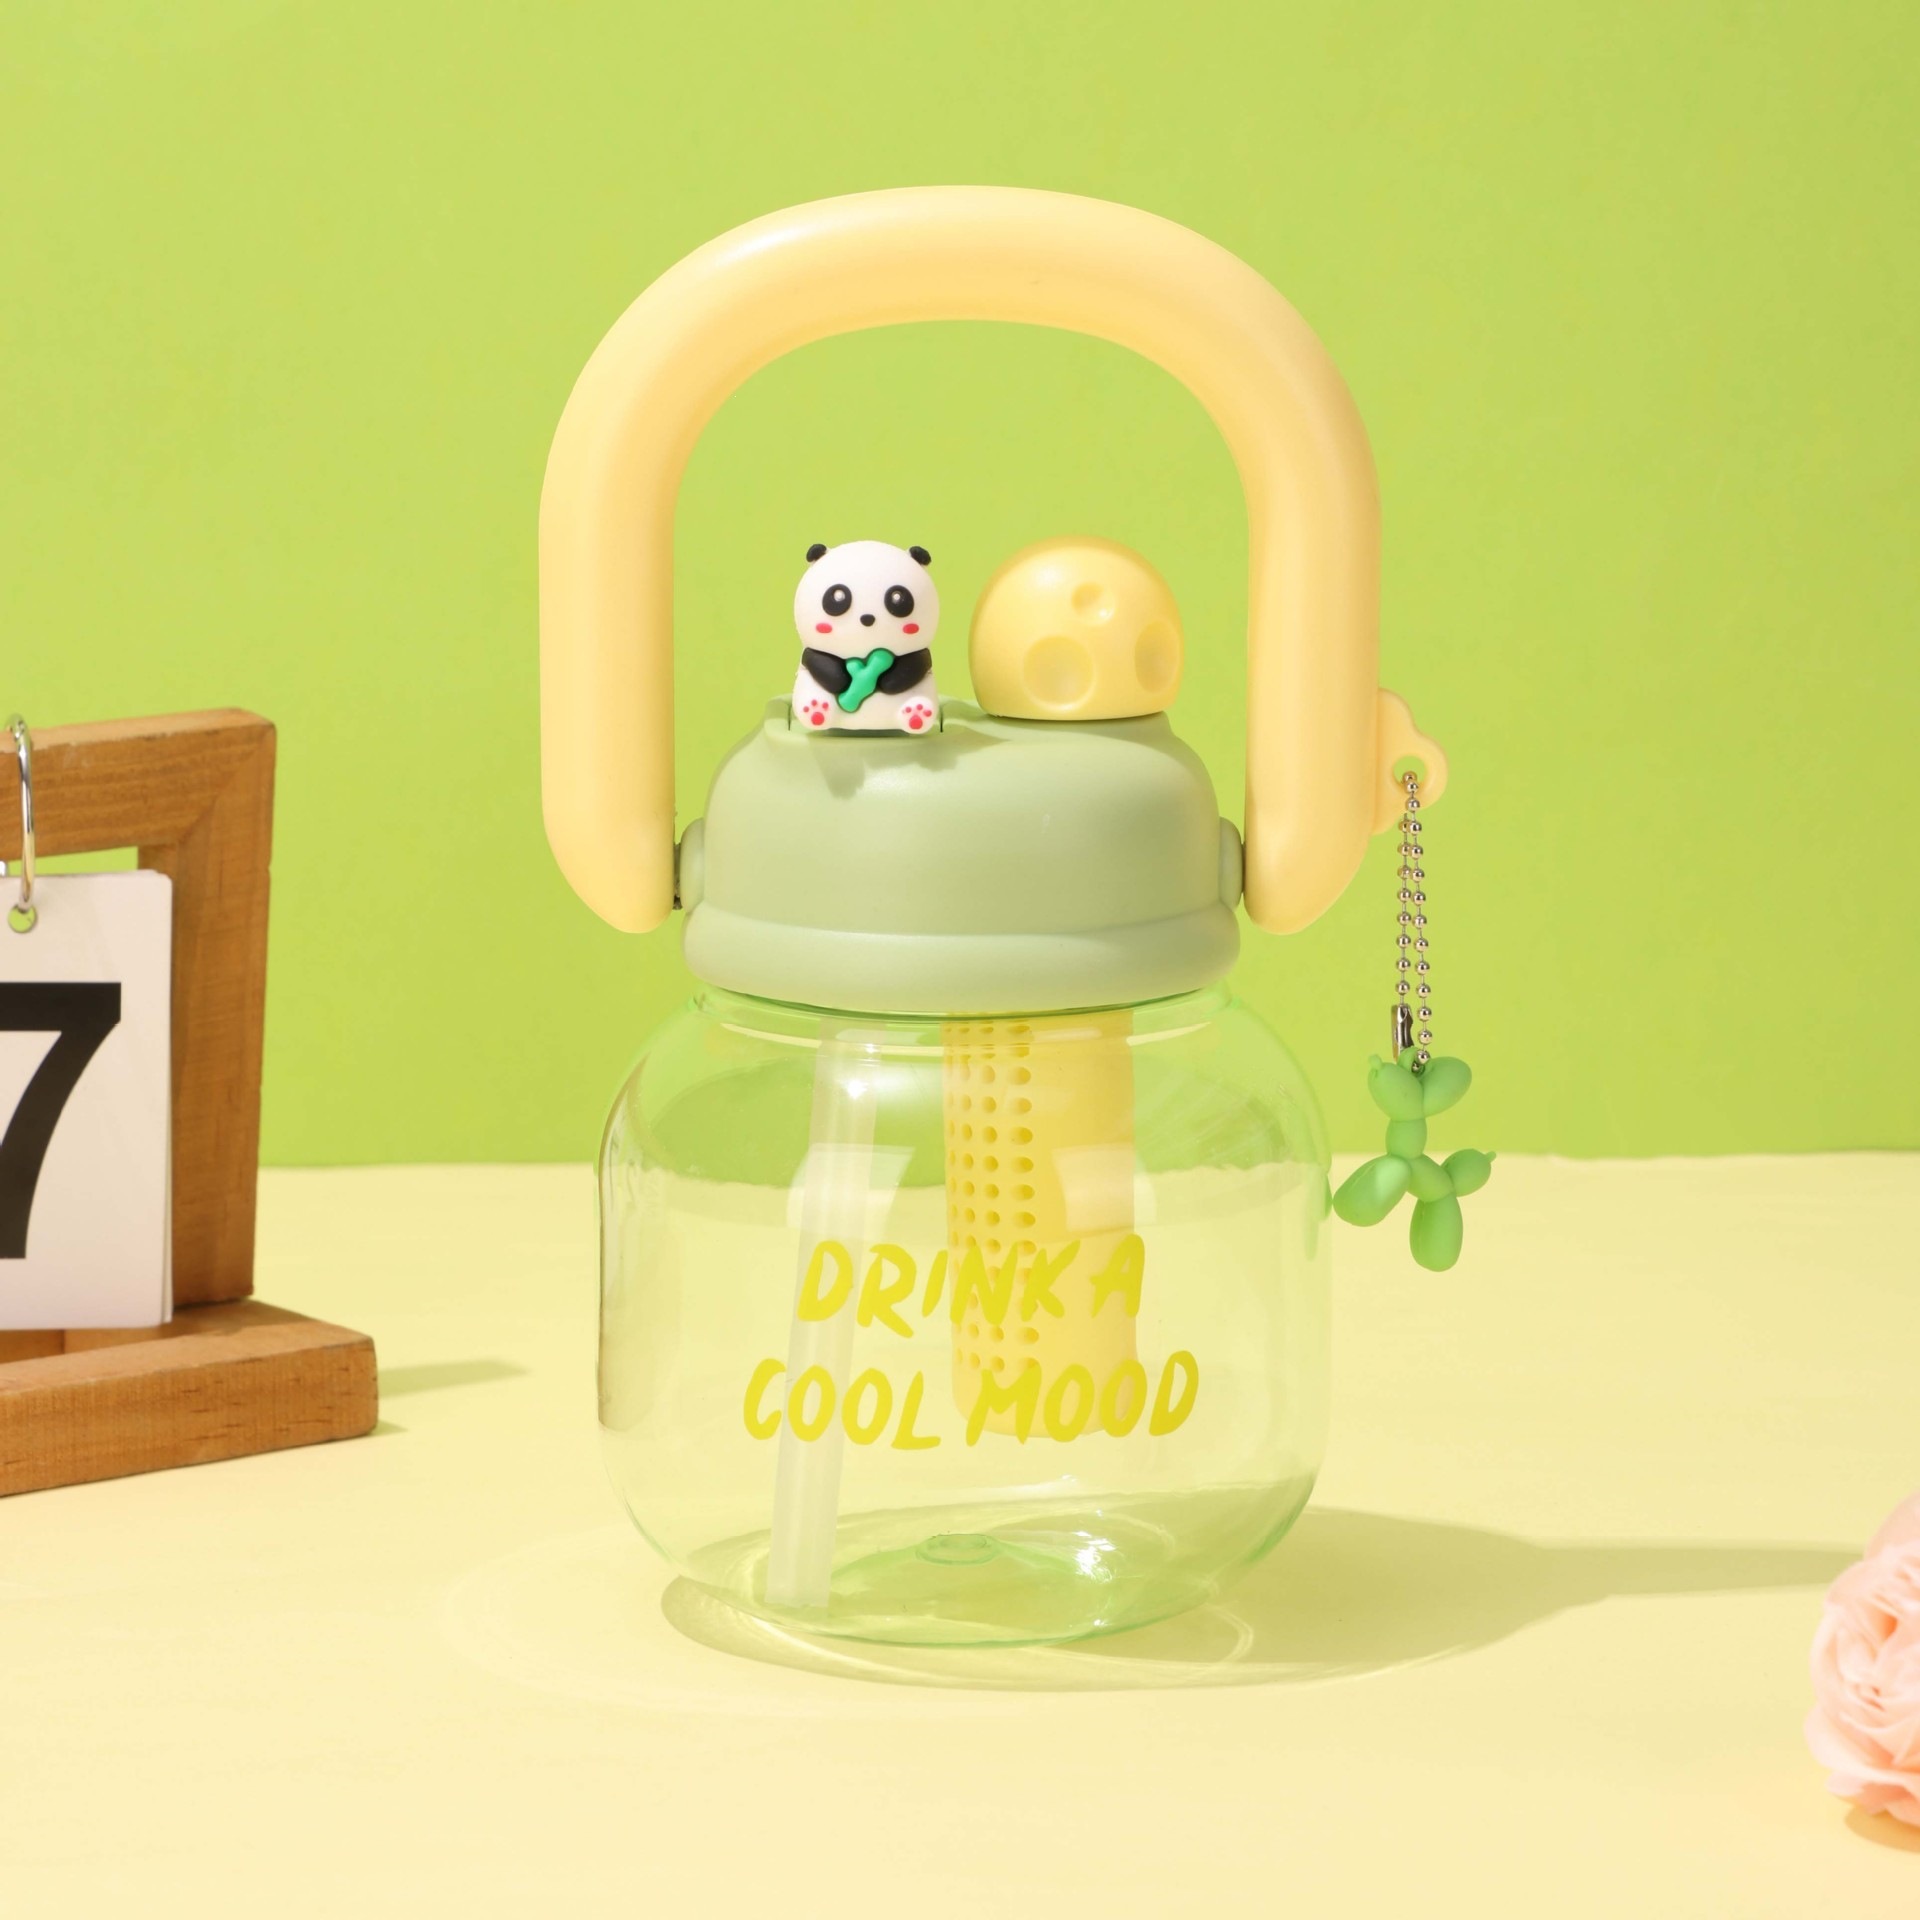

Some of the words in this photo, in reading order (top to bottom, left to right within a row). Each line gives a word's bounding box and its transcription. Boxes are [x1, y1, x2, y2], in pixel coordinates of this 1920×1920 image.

[0, 981, 121, 1259] 7
[797, 1240, 1081, 1339] DRINK
[1089, 1233, 1146, 1318] A
[743, 1358, 942, 1450] COOL
[965, 1350, 1199, 1447] MOOD
